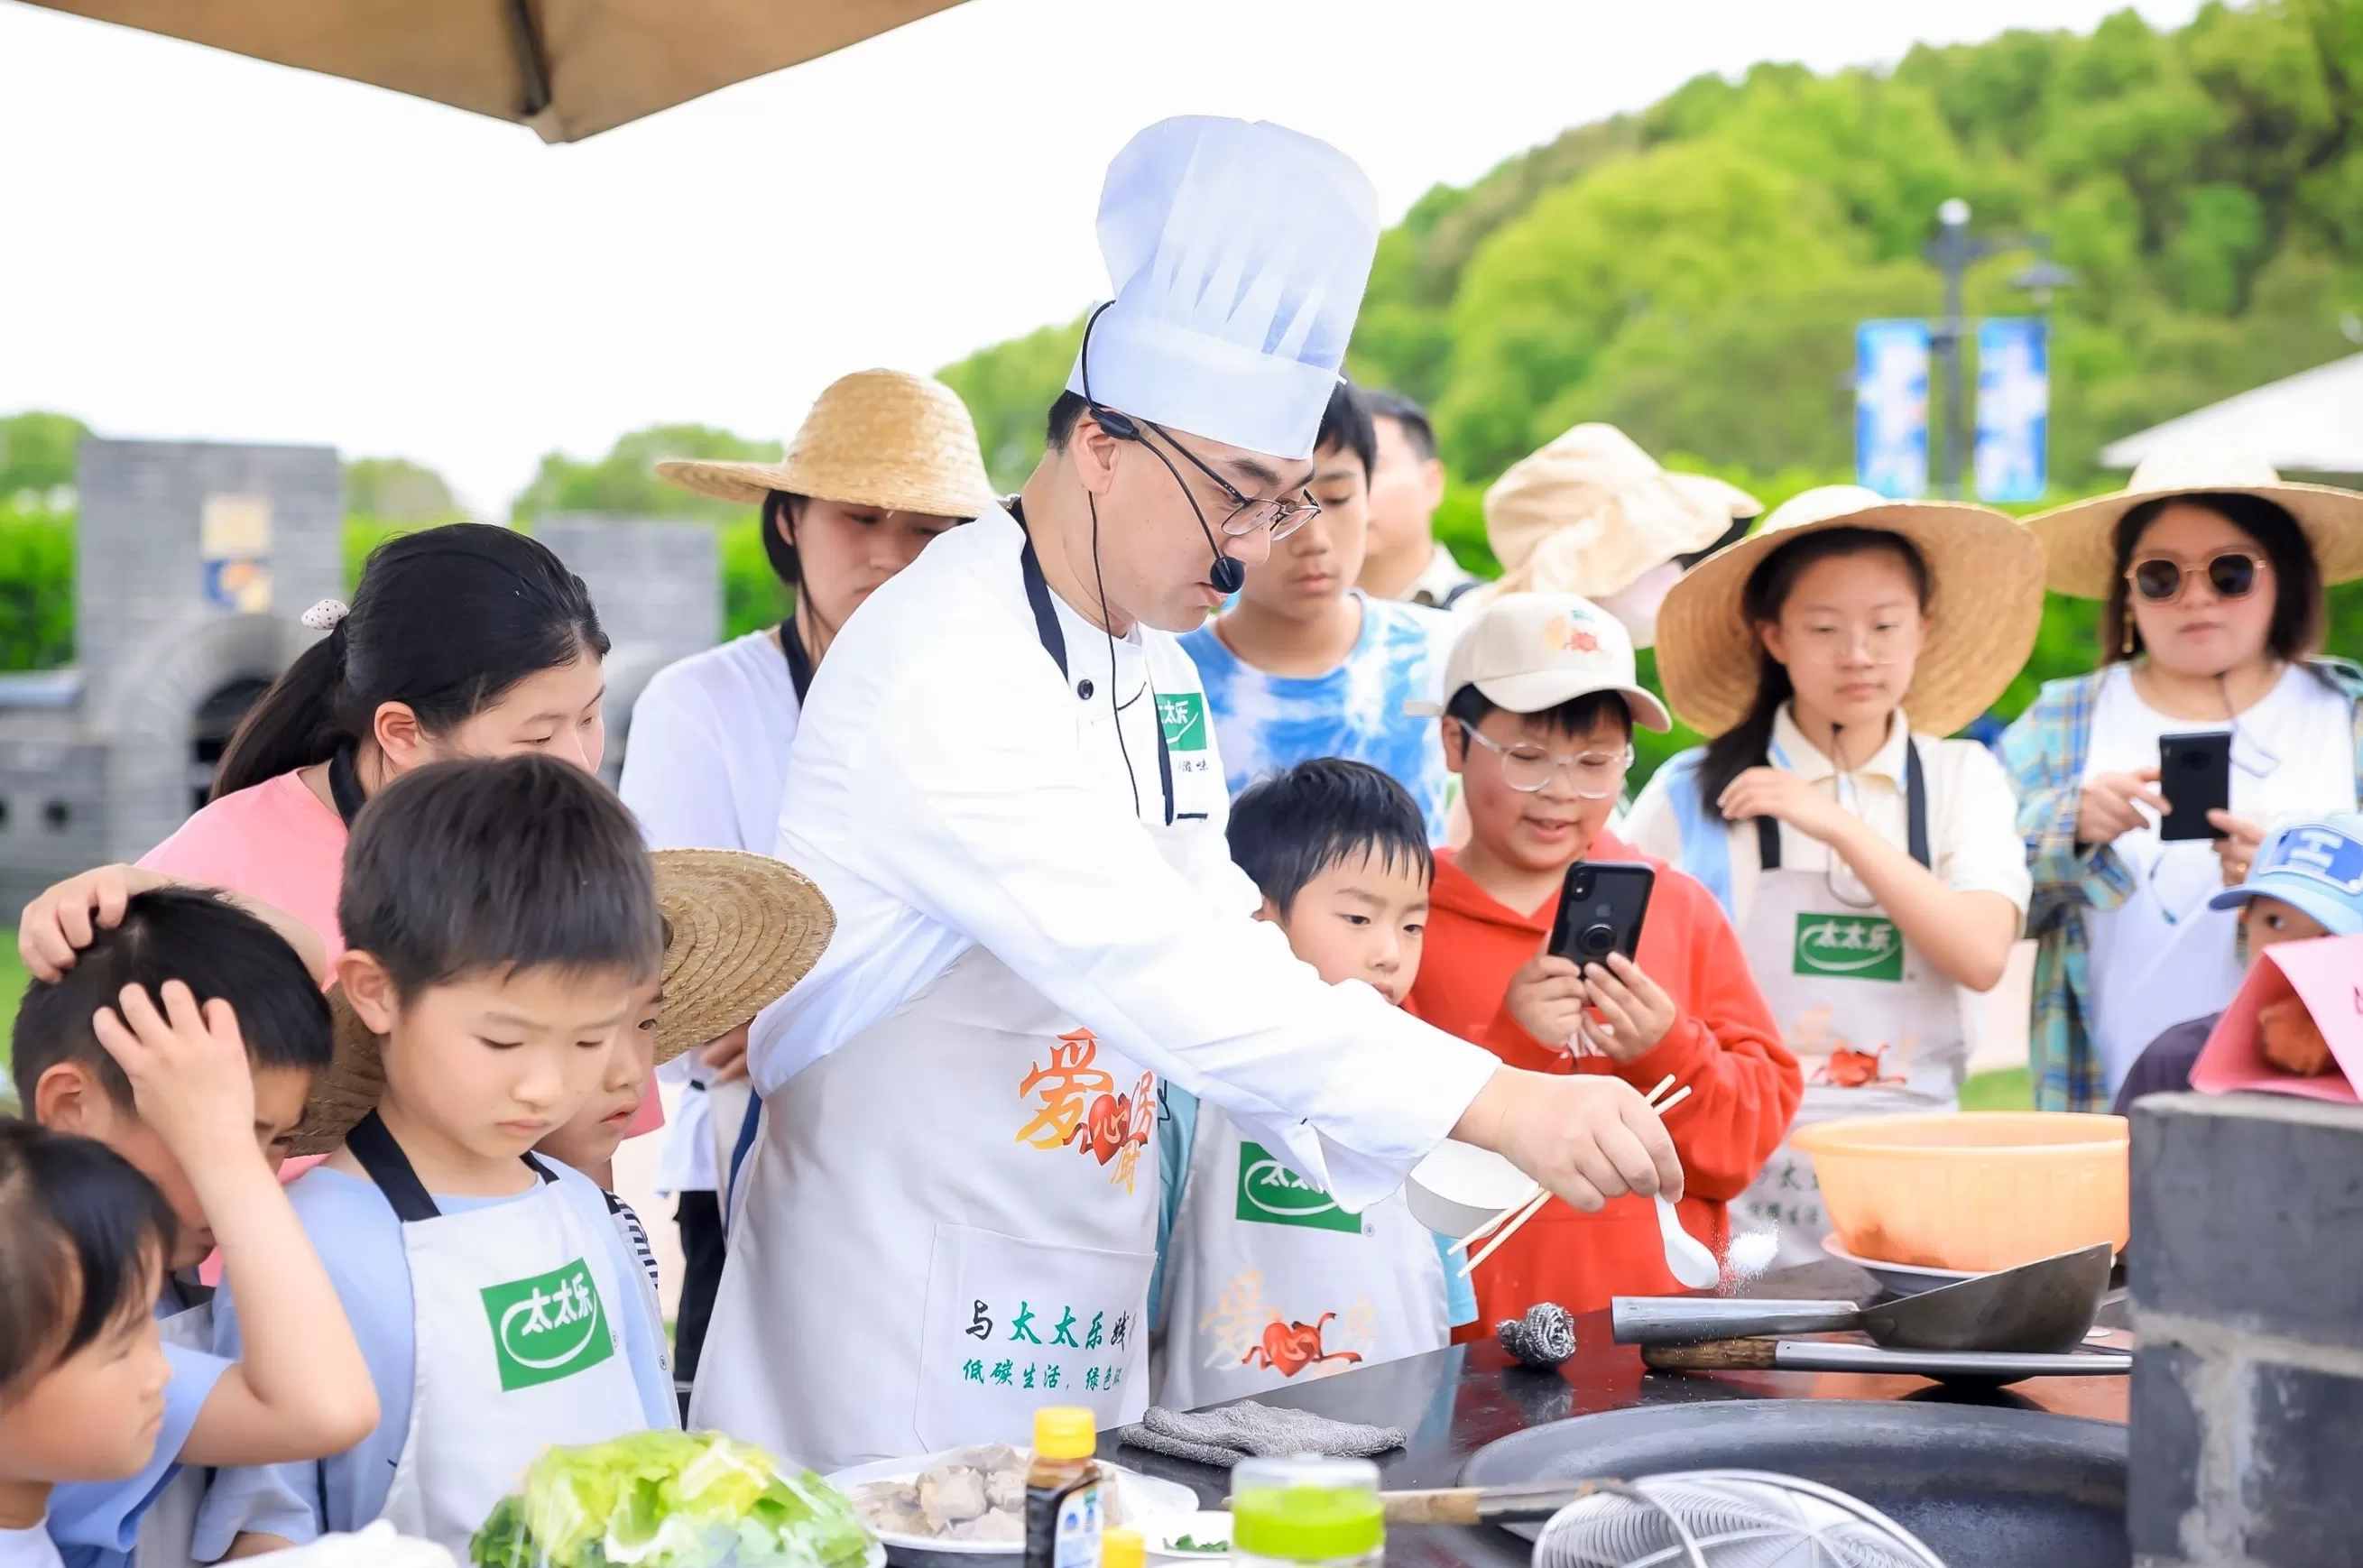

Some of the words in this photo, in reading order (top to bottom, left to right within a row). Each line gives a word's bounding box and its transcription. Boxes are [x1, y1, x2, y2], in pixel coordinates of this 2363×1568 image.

[1179, 759, 1209, 773] 滋味
[1813, 918, 1893, 952] 太太乐
[521, 1271, 594, 1337] 太太乐
[965, 1299, 1138, 1354] 与太太乐践
